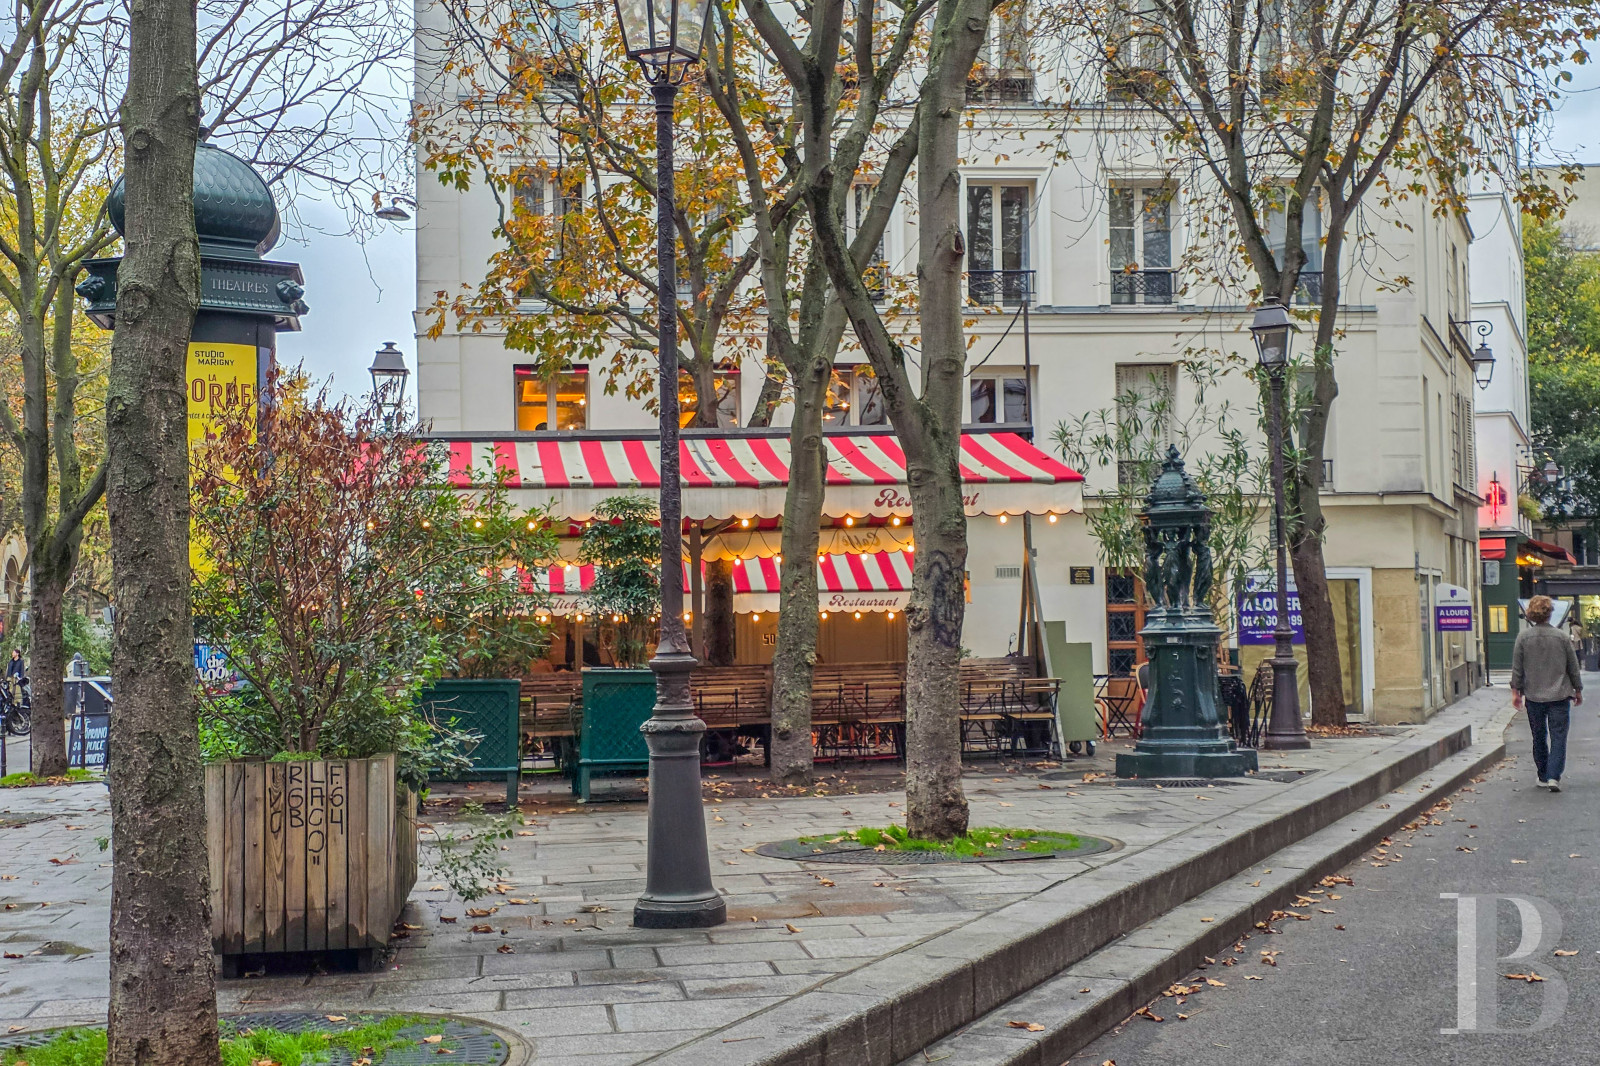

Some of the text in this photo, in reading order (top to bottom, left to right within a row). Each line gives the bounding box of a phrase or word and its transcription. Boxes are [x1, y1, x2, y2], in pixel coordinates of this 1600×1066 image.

[210, 278, 269, 293] THEATRES
[195, 350, 225, 358] STUDIO
[197, 358, 235, 366] MARIGNY
[208, 374, 217, 382] LA
[828, 594, 899, 607] Restaurant
[207, 655, 225, 669] the
